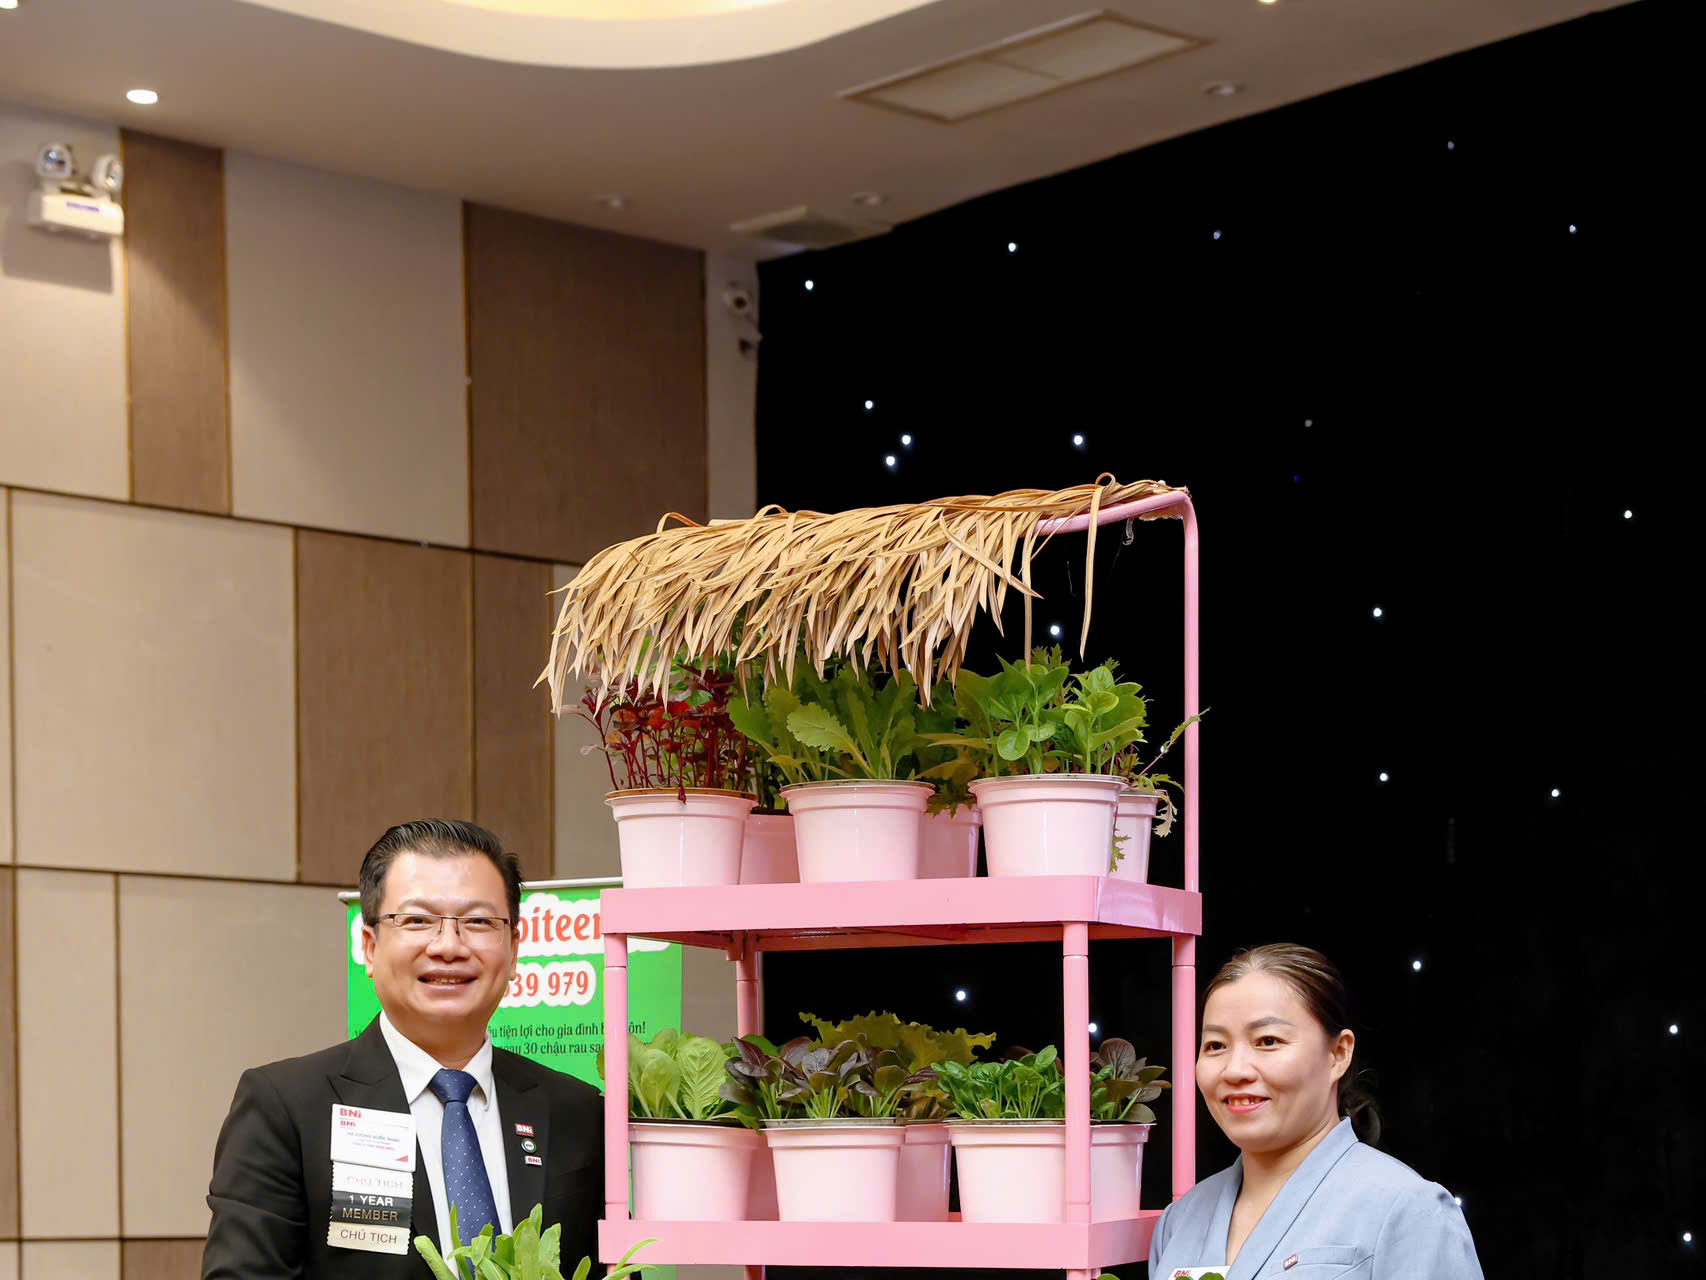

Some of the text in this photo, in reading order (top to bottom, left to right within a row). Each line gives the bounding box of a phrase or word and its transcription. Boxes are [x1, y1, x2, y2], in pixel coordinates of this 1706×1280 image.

[548, 970, 589, 996] 979
[499, 1024, 518, 1040] tiện
[520, 1024, 532, 1039] lợi
[535, 1024, 555, 1037] cho
[557, 1024, 573, 1039] gia
[523, 1042, 538, 1054] 30
[541, 1042, 567, 1057] chậu
[568, 1044, 587, 1054] rau
[348, 1195, 394, 1207] 1 YEAR
[342, 1207, 398, 1221] MEMBER
[340, 1228, 397, 1244] CHỦ TỊCH
